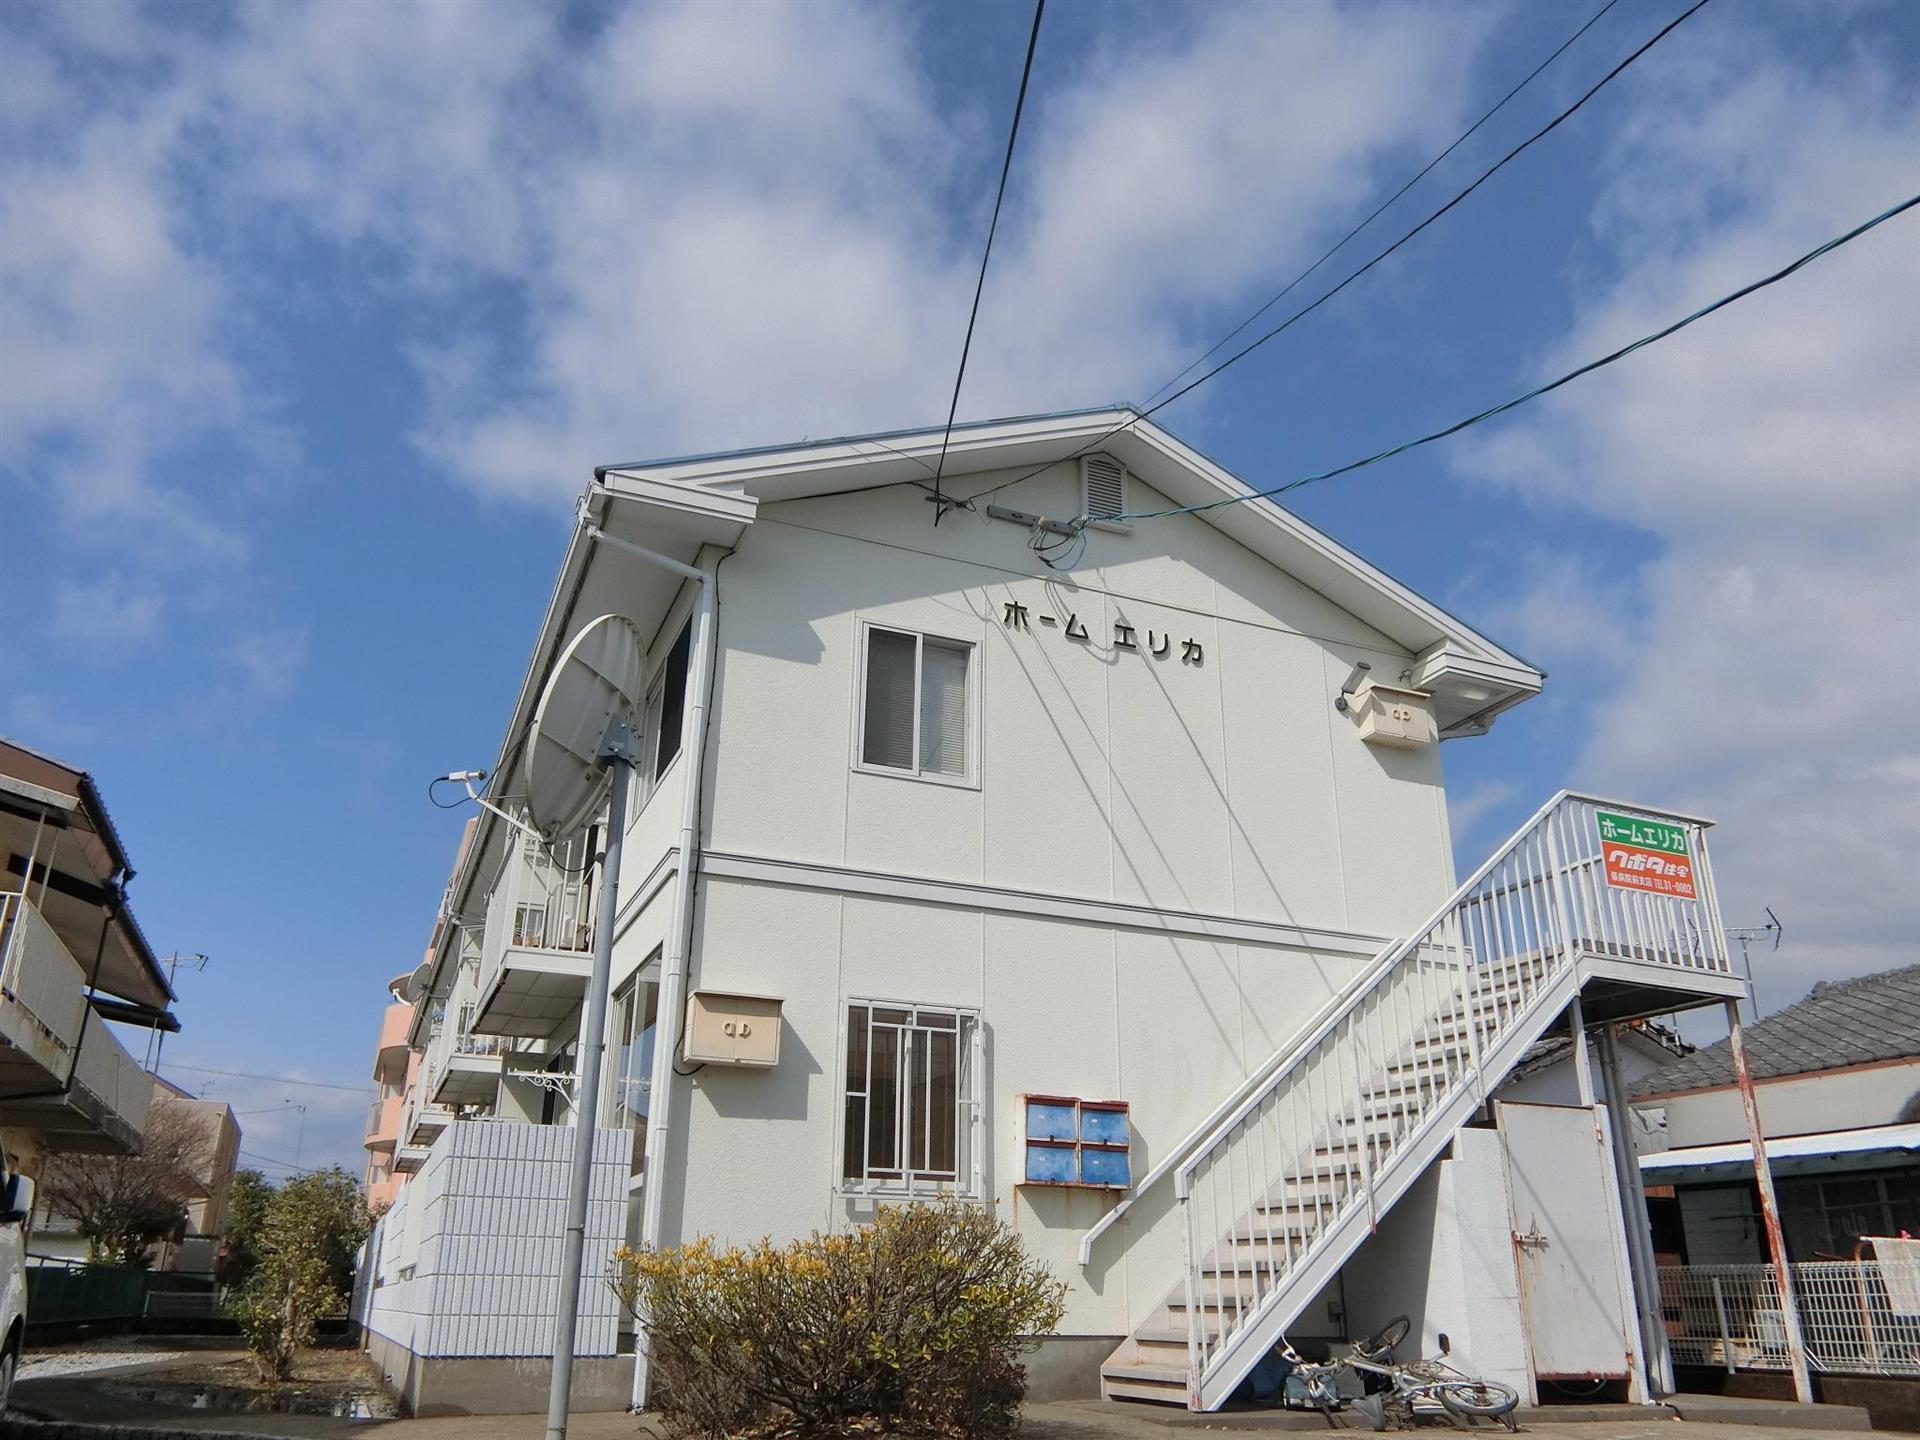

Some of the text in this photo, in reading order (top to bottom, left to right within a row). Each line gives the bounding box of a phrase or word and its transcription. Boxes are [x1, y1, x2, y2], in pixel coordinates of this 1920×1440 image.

[1601, 818, 1685, 851] ホームエリカ
